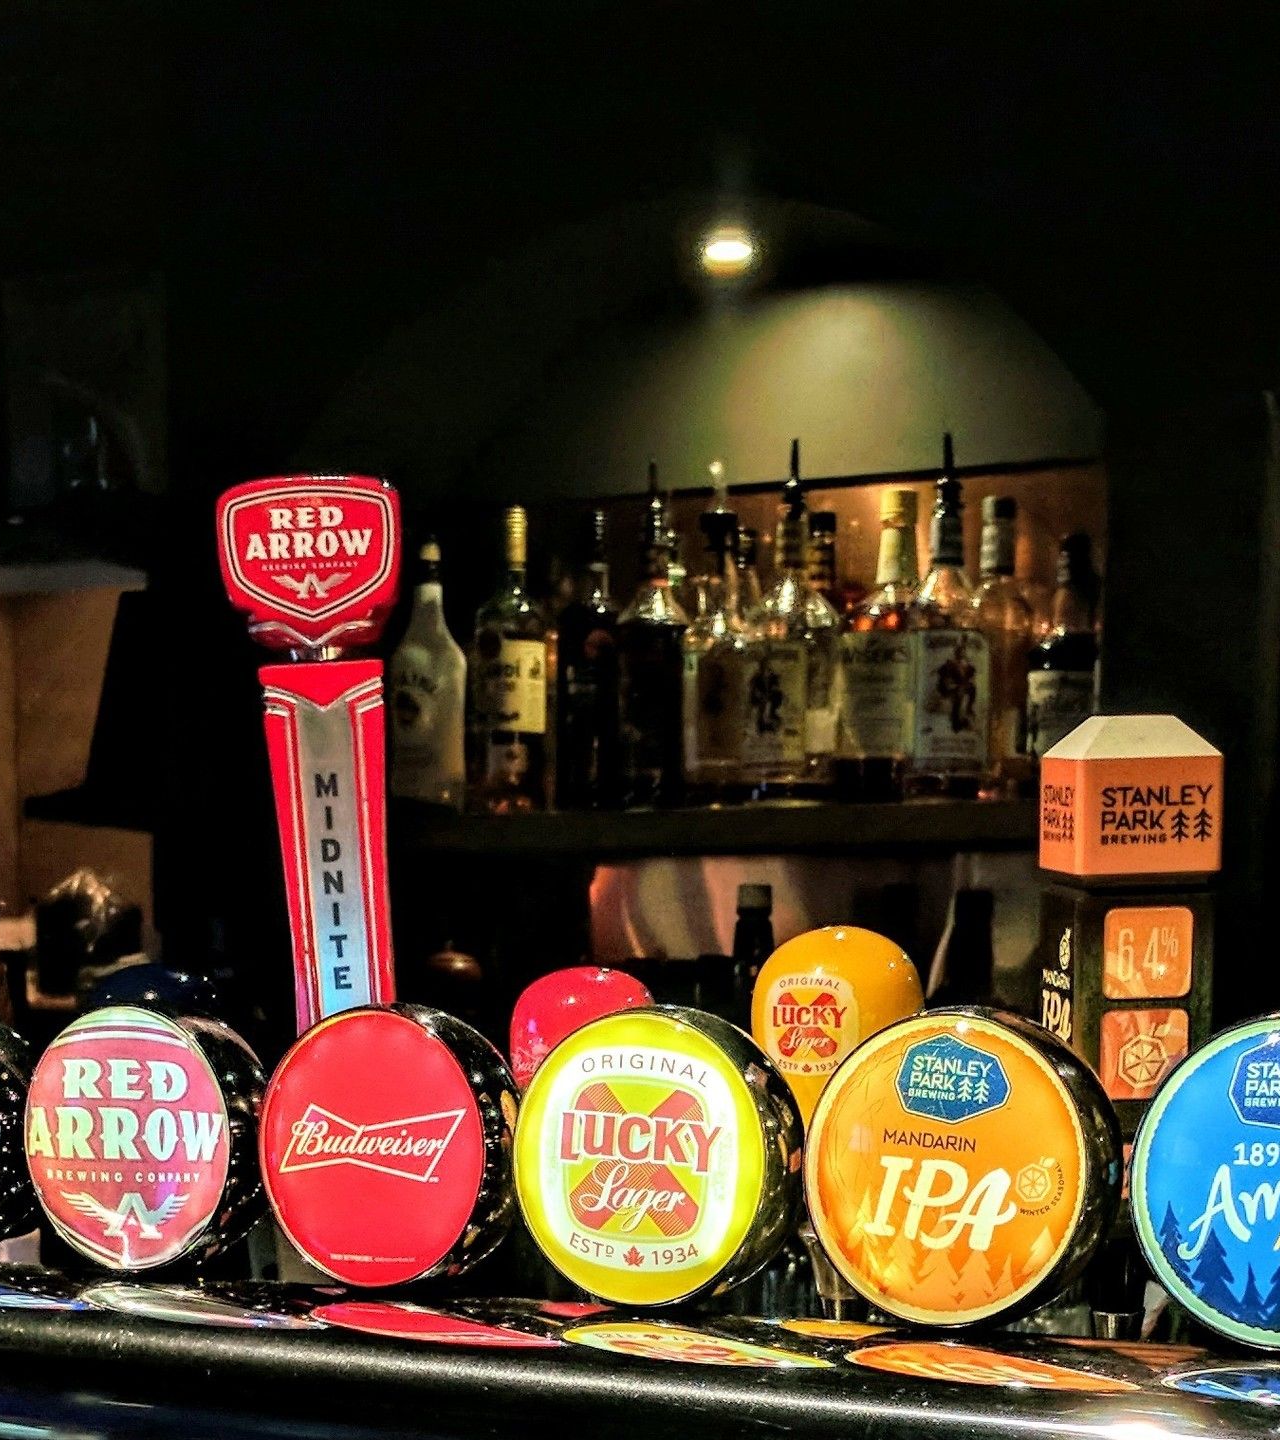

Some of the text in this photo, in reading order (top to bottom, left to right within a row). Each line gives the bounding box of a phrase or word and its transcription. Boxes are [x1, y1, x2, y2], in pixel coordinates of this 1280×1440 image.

[269, 506, 345, 531] RED
[246, 528, 373, 561] ARROW
[1101, 784, 1214, 808] STANLEY
[1101, 809, 1166, 832] PARK
[1101, 834, 1168, 846] BREWING
[314, 773, 352, 990] MIDNITE
[778, 975, 842, 991] ORIGINAL
[773, 1004, 848, 1029] LUCKY
[784, 1026, 830, 1055] Lager
[581, 1052, 709, 1088] ORIGINAL
[815, 1060, 840, 1072] 1934
[912, 1055, 991, 1078] STANLEY
[61, 1059, 189, 1100] RED
[911, 1073, 957, 1091] PARK
[908, 1088, 956, 1101] BREWING
[27, 1107, 223, 1161] ARROW
[292, 1118, 448, 1158] Budweiser
[561, 1109, 722, 1174] LUCKY
[882, 1129, 977, 1152] MANDARIN
[47, 1170, 201, 1184] BREWING COMPANY
[1019, 1161, 1065, 1217] WINTER SEASONAL
[592, 1165, 686, 1233] Lager
[864, 1153, 1018, 1253] IPA
[651, 1245, 700, 1265] 1934
